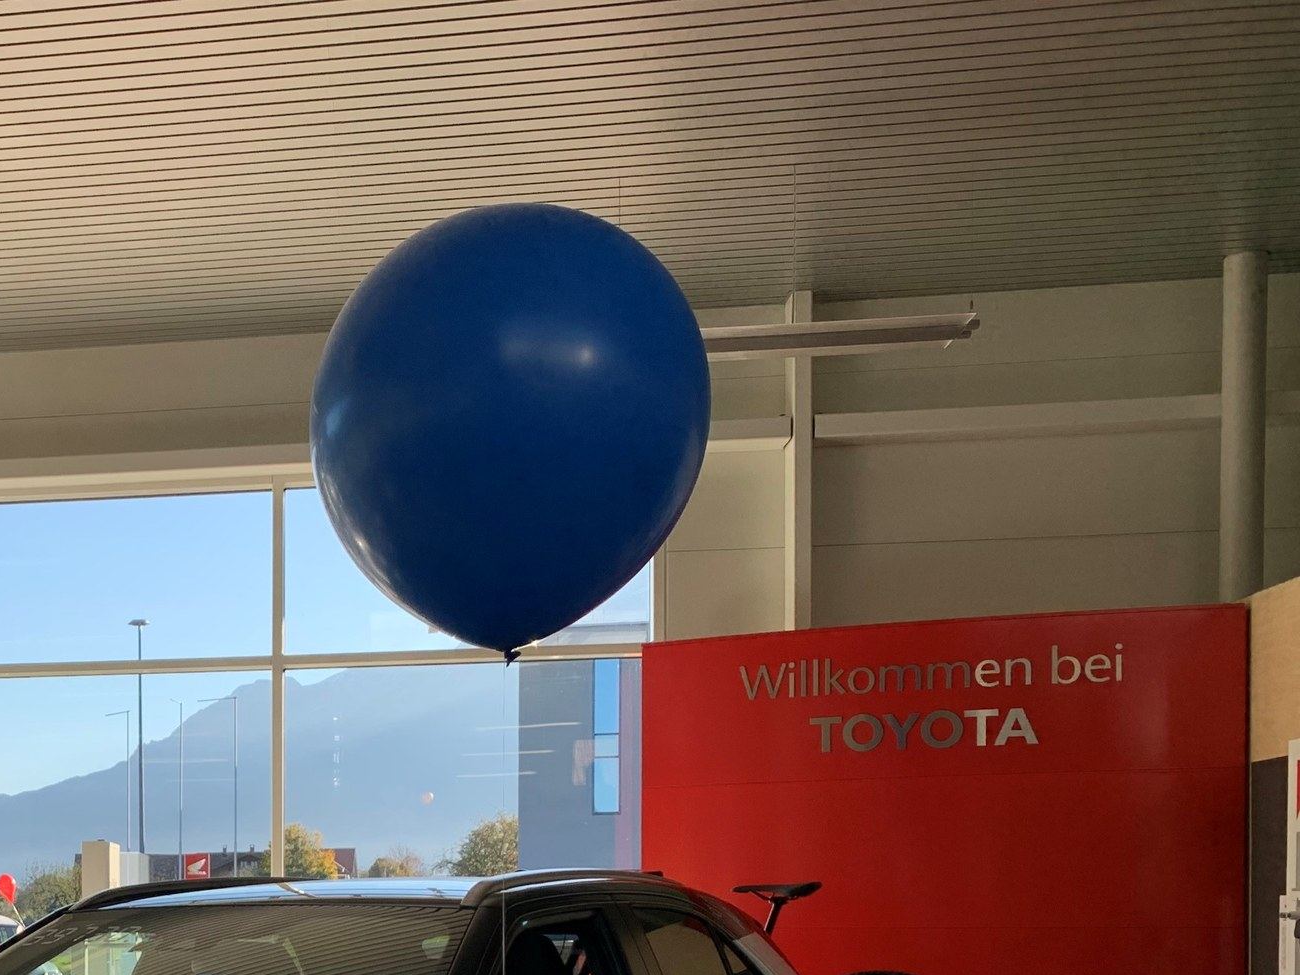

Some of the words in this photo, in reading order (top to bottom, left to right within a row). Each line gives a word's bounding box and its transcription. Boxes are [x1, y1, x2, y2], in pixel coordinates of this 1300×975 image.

[739, 656, 1032, 701] Willkommen
[1051, 643, 1125, 685] bei
[810, 708, 1039, 753] TOYOTA
